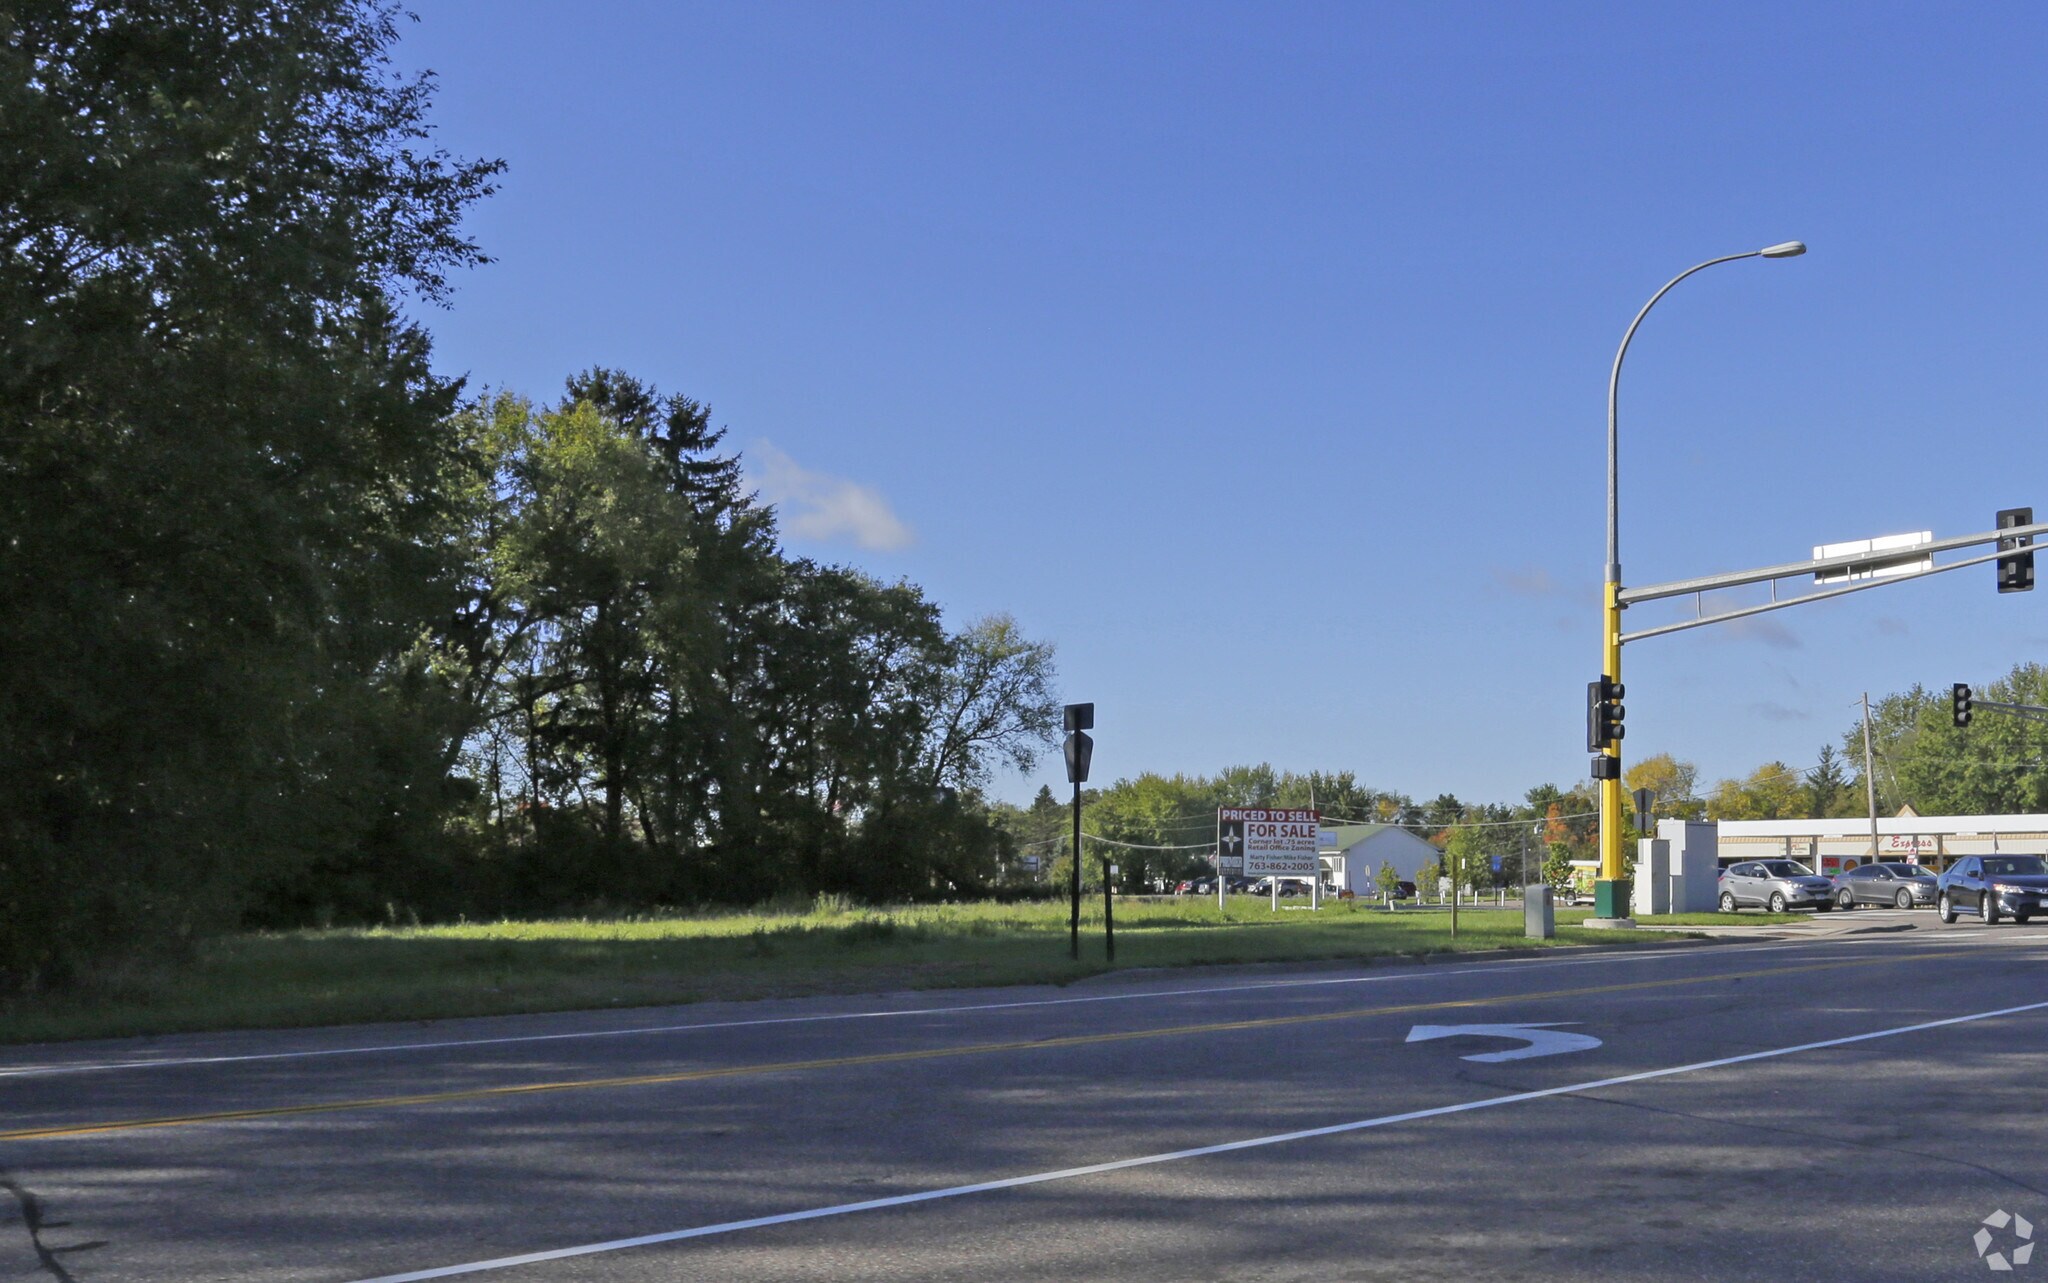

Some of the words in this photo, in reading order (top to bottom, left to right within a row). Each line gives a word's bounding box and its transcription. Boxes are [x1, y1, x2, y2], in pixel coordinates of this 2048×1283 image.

[1222, 810, 1267, 821] PRICED
[1269, 811, 1286, 821] TO
[1288, 811, 1317, 822] SELL
[1248, 824, 1277, 837] FOR
[1280, 824, 1316, 838] SALE
[1291, 845, 1316, 853] Zoning
